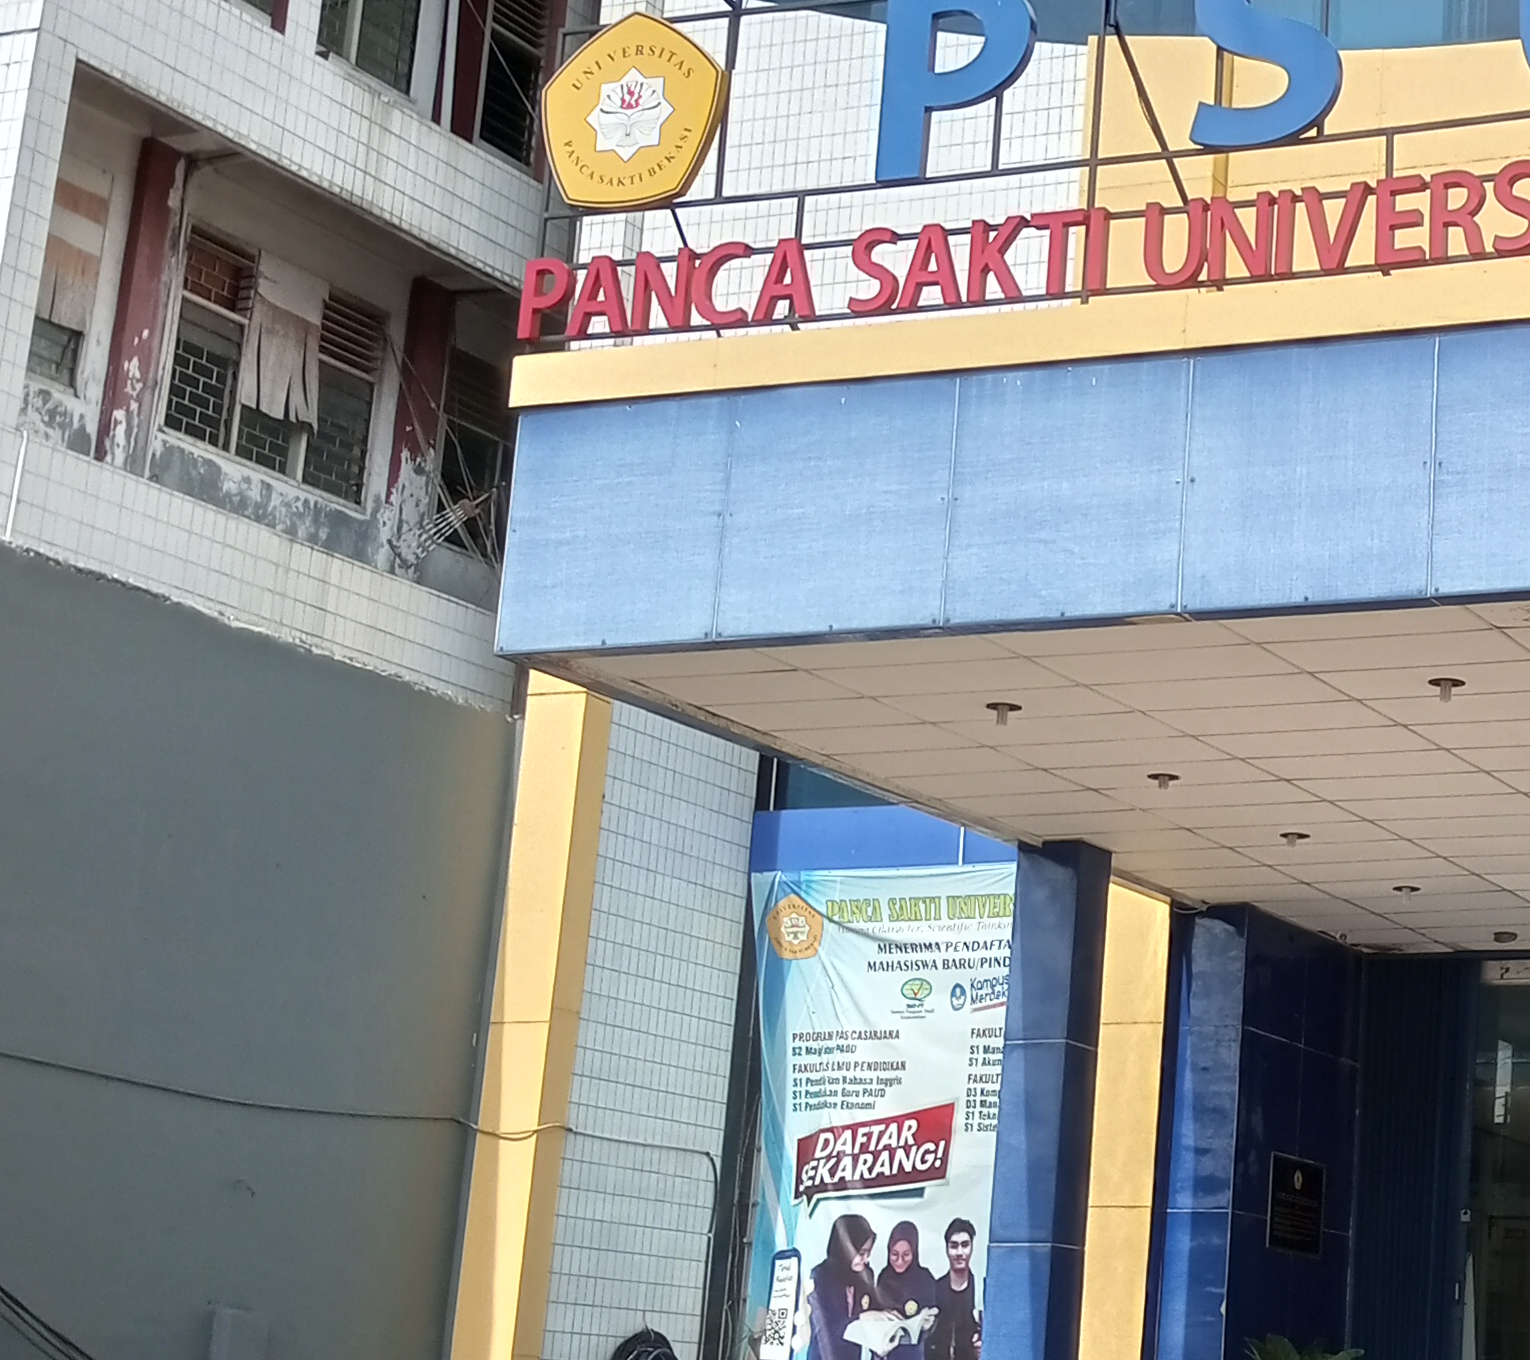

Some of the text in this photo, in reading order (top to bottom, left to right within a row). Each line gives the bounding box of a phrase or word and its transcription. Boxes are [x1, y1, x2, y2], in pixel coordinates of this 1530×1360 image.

[571, 44, 695, 91] UNIVERSITAS
[563, 126, 693, 187] PANCA SAKTI BEKASI
[515, 237, 815, 341] PANCA
[847, 204, 1110, 316] SAKTI
[826, 894, 1014, 924] PANCA SAKTI UNIVER
[877, 941, 941, 955] MENERIMA
[867, 958, 939, 973] MAHASISWA
[970, 1045, 980, 1055] S1
[968, 1057, 979, 1067] S1
[862, 1087, 886, 1098] PAUD
[966, 1087, 977, 1097] D3
[966, 1099, 977, 1109] D3
[965, 1110, 975, 1121] S1
[814, 1119, 918, 1159] DAFTAR
[800, 1140, 945, 1191] SEKARANG!
